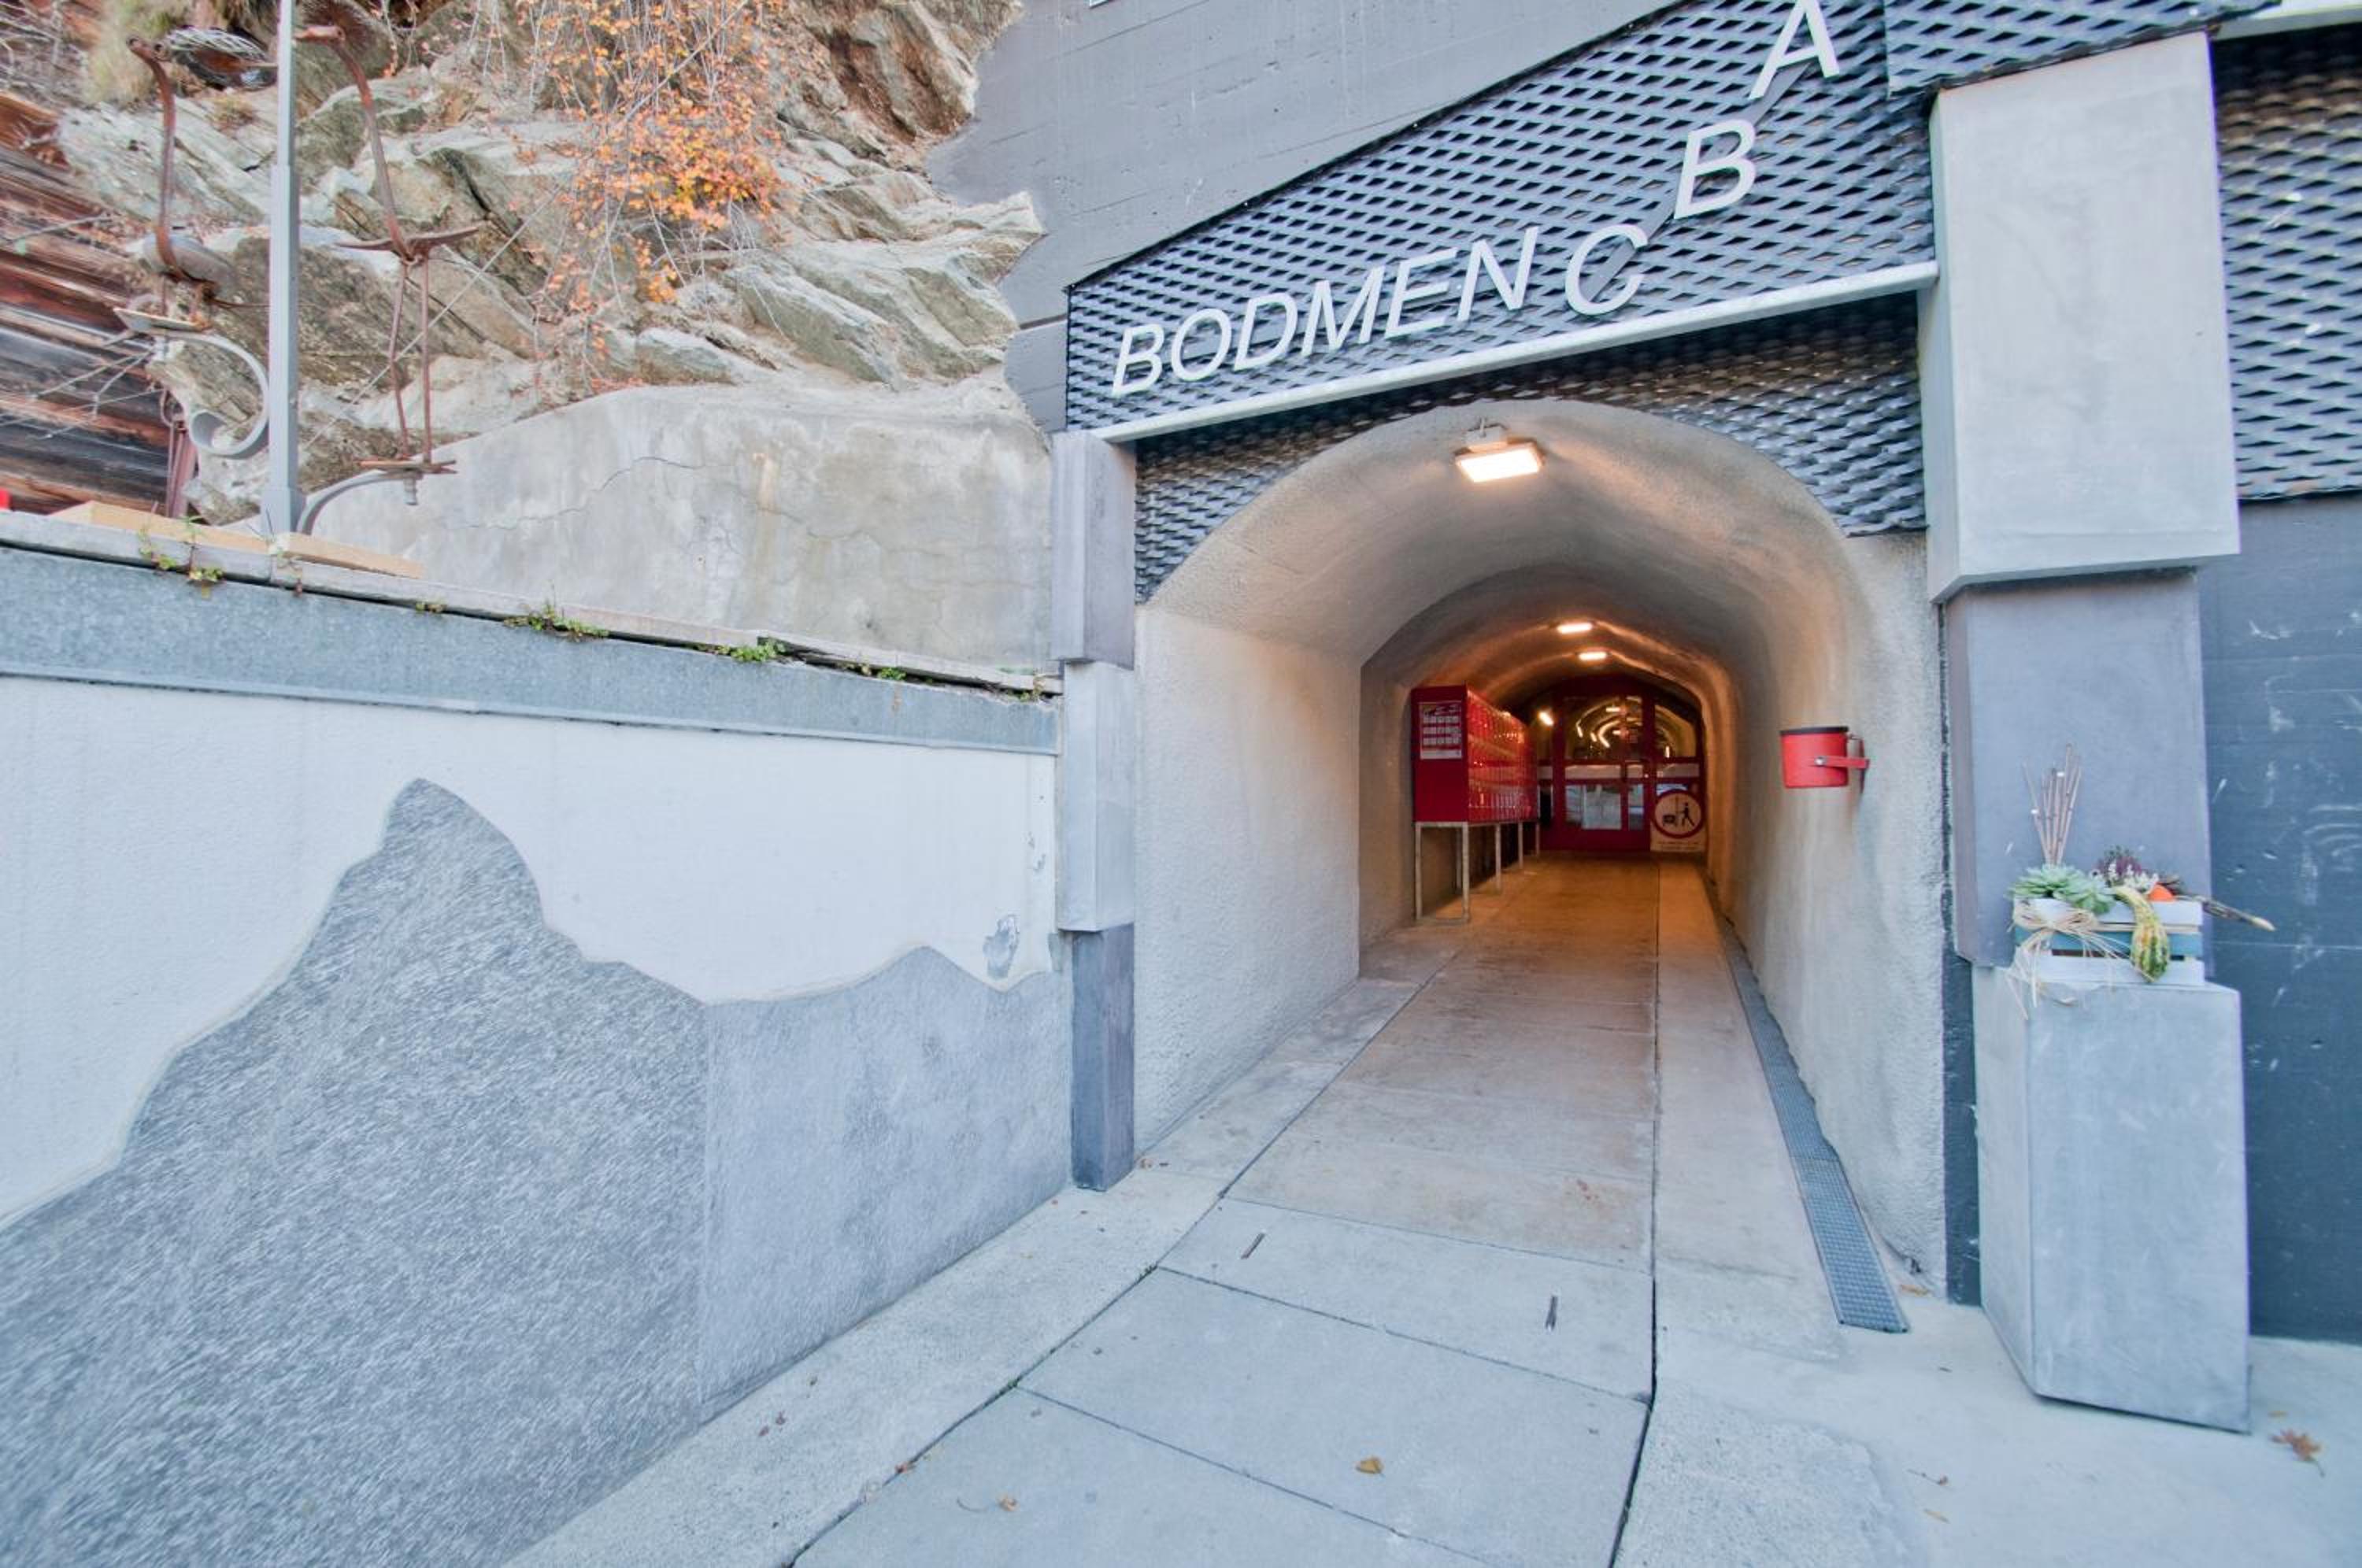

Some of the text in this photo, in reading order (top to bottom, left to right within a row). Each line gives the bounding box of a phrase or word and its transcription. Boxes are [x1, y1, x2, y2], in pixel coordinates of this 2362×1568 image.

[1747, 0, 1840, 100] A
[1674, 118, 1757, 220] B
[1112, 225, 1539, 396] BODMEN
[1564, 224, 1649, 316] C
